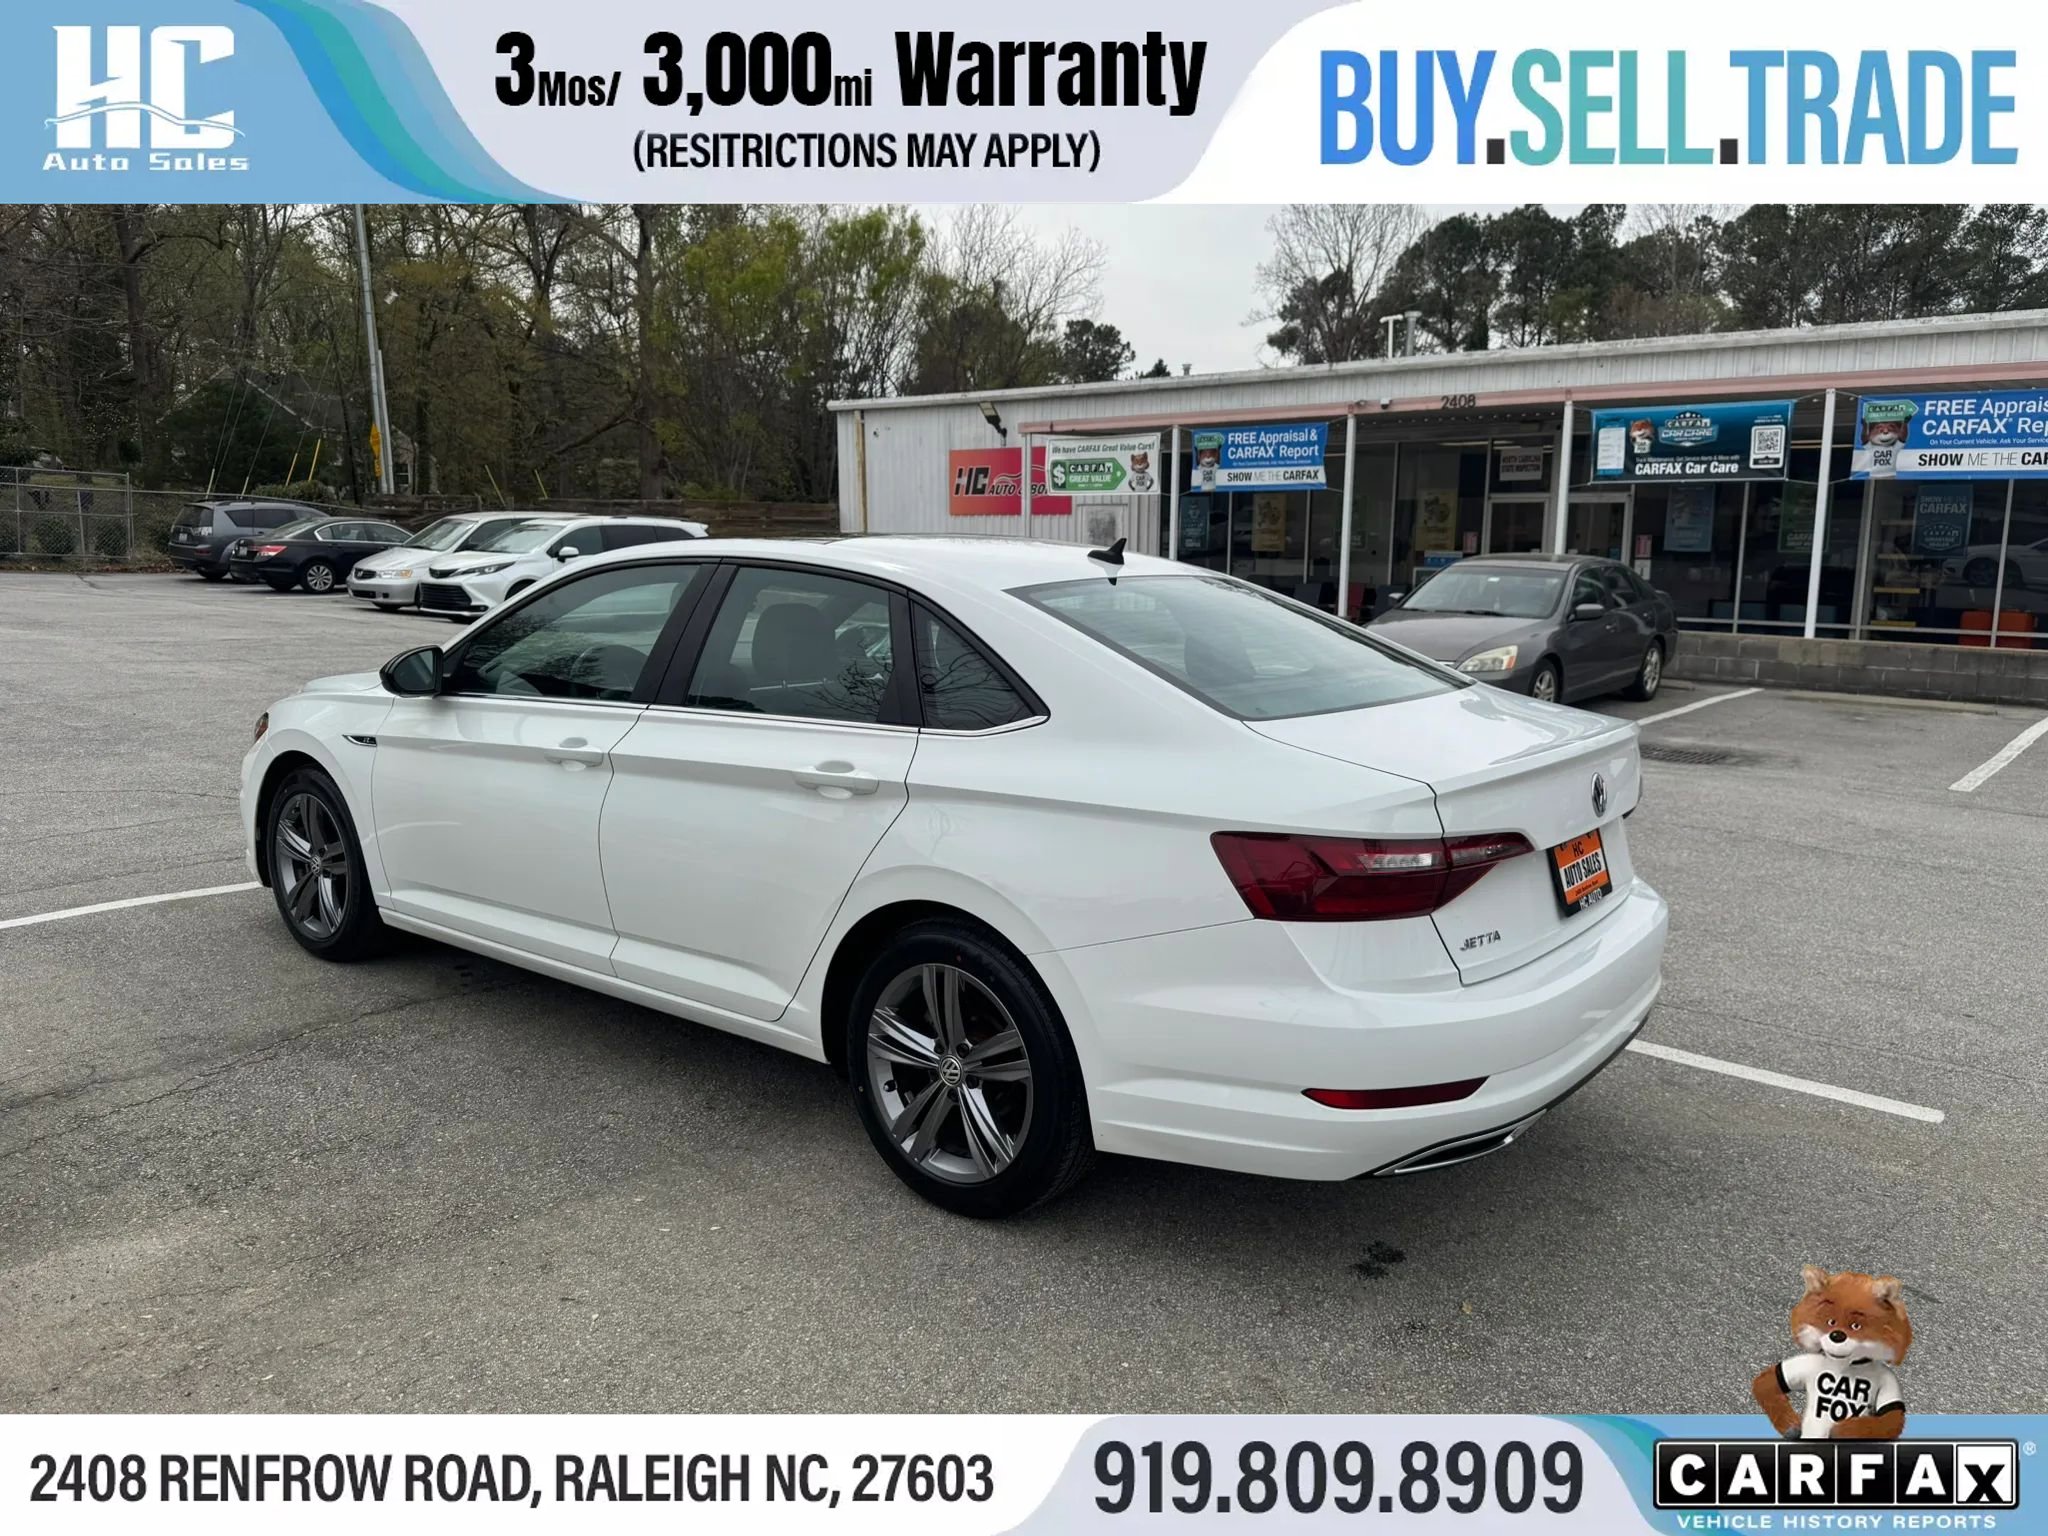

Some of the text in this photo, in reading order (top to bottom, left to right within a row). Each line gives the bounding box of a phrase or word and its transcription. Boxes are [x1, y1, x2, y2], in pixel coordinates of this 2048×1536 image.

[1440, 394, 1476, 409] 2408
[1924, 399, 1977, 416] FREE
[1228, 432, 1257, 445] FREE
[1258, 429, 1308, 447] Appraisal
[1309, 428, 1318, 441] &
[1077, 444, 1101, 453] CARFAX
[1279, 444, 1319, 460] Report
[1873, 450, 1892, 459] CAR
[1873, 459, 1891, 467] FOX
[1918, 453, 1964, 467] SHOW
[1967, 453, 1989, 466] ME
[1992, 452, 2018, 466] THE
[1069, 462, 1113, 473] CARFAX
[1635, 461, 1739, 475] CARFAX Car Care
[1227, 471, 1253, 483] SHOW
[1283, 469, 1319, 481] CARFAX
[988, 484, 1016, 495] AUTO
[1920, 503, 1967, 514] CARFAX
[1572, 841, 1584, 857] HC
[1564, 861, 1584, 889] AUTO
[1581, 852, 1602, 878] SALES
[1460, 930, 1501, 951] JETTA
